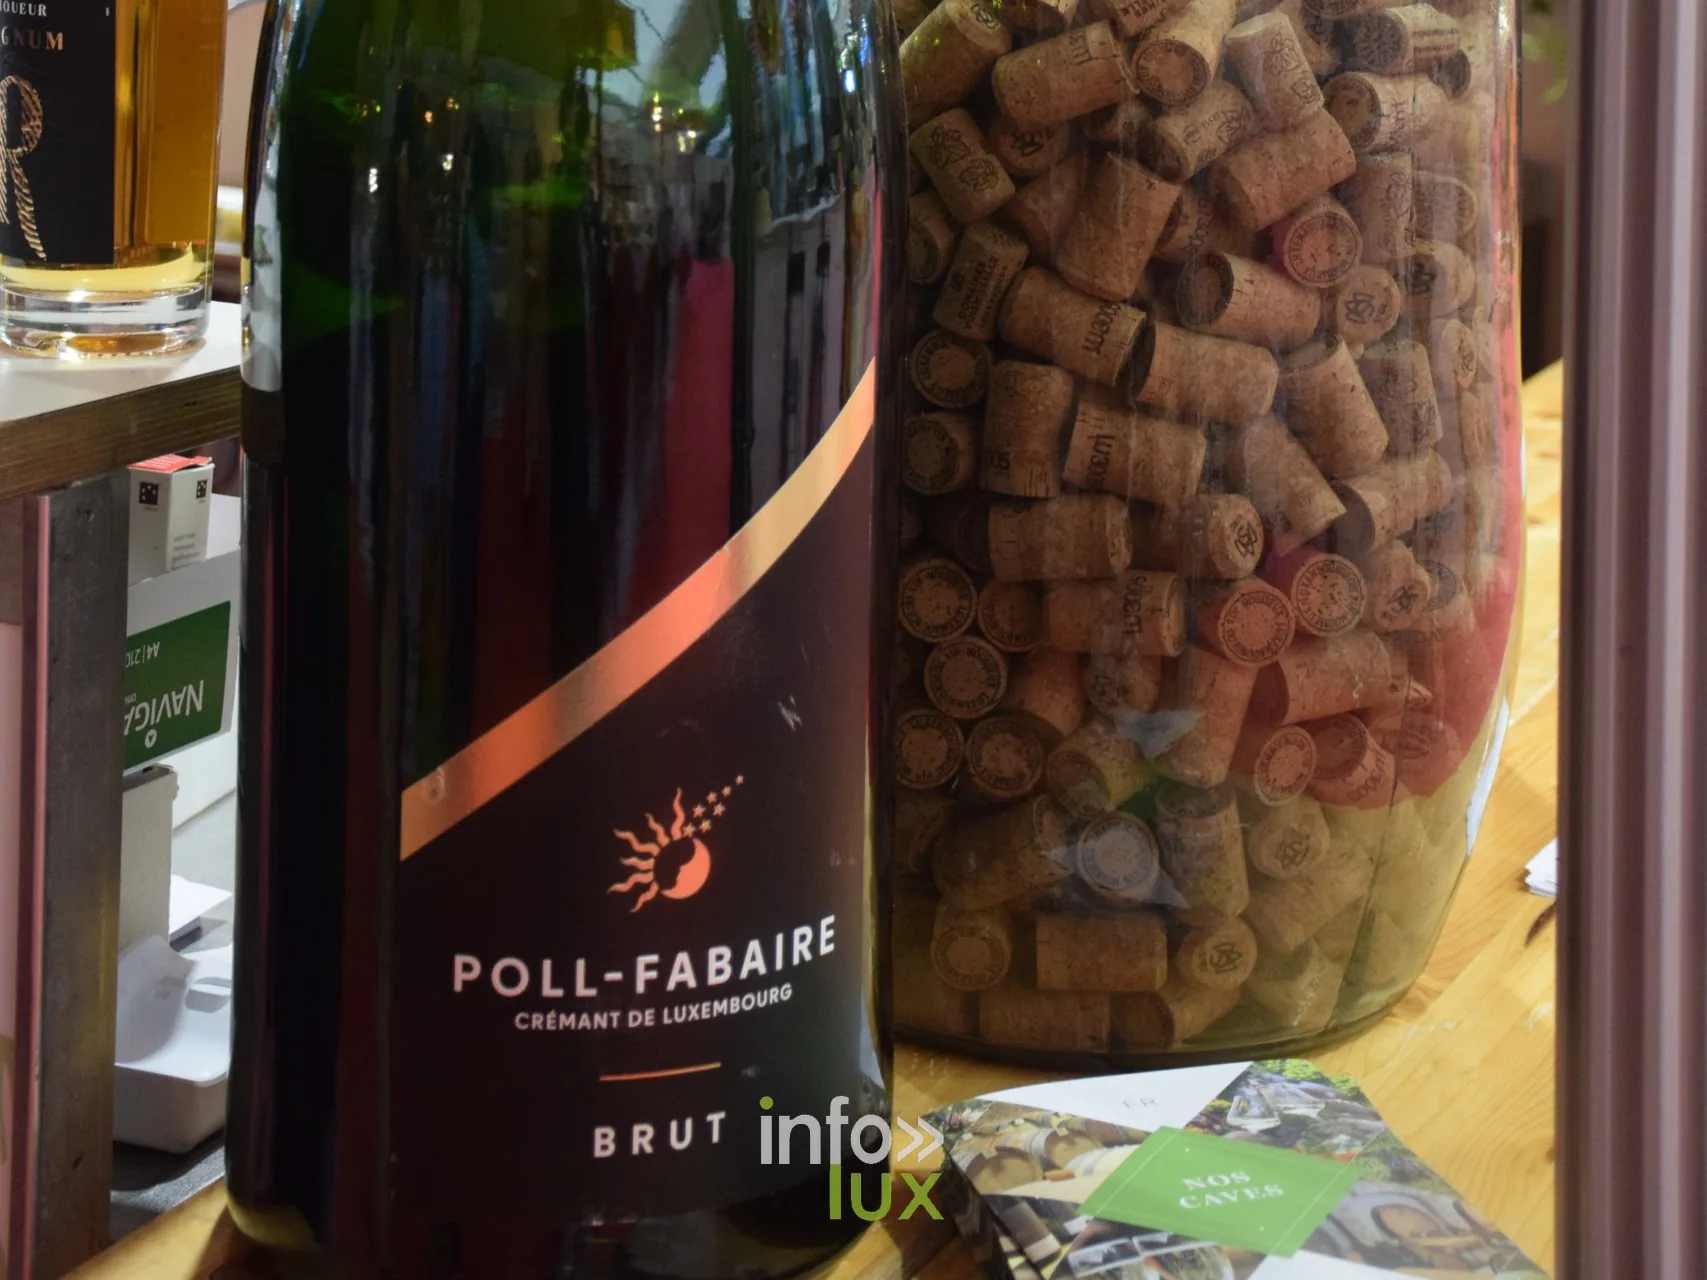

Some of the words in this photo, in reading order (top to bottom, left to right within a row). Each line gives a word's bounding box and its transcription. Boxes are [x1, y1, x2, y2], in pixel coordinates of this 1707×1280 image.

[147, 641, 160, 660] A4
[453, 915, 837, 998] POLL-FABAIRE
[515, 1009, 620, 1030] CRÉMANT
[628, 1008, 655, 1028] DE
[662, 982, 793, 1025] LUXEMBOURG
[594, 1111, 726, 1158] BRUT
[1179, 1184, 1284, 1209] CAVES
[1181, 1170, 1250, 1191] NOS
